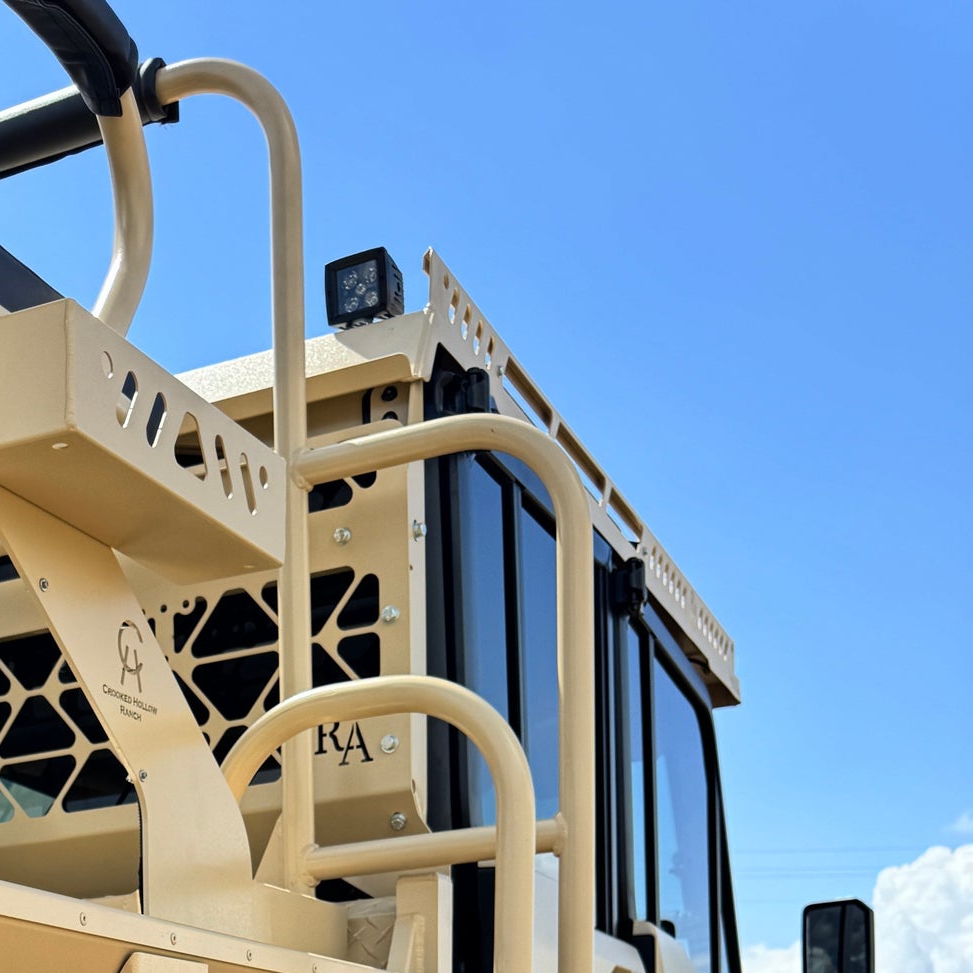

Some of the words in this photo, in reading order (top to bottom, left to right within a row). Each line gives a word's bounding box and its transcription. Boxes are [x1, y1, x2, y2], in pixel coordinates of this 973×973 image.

[102, 684, 132, 704] CROOKED
[133, 697, 158, 715] HOLLOW
[120, 705, 142, 721] RANCH
